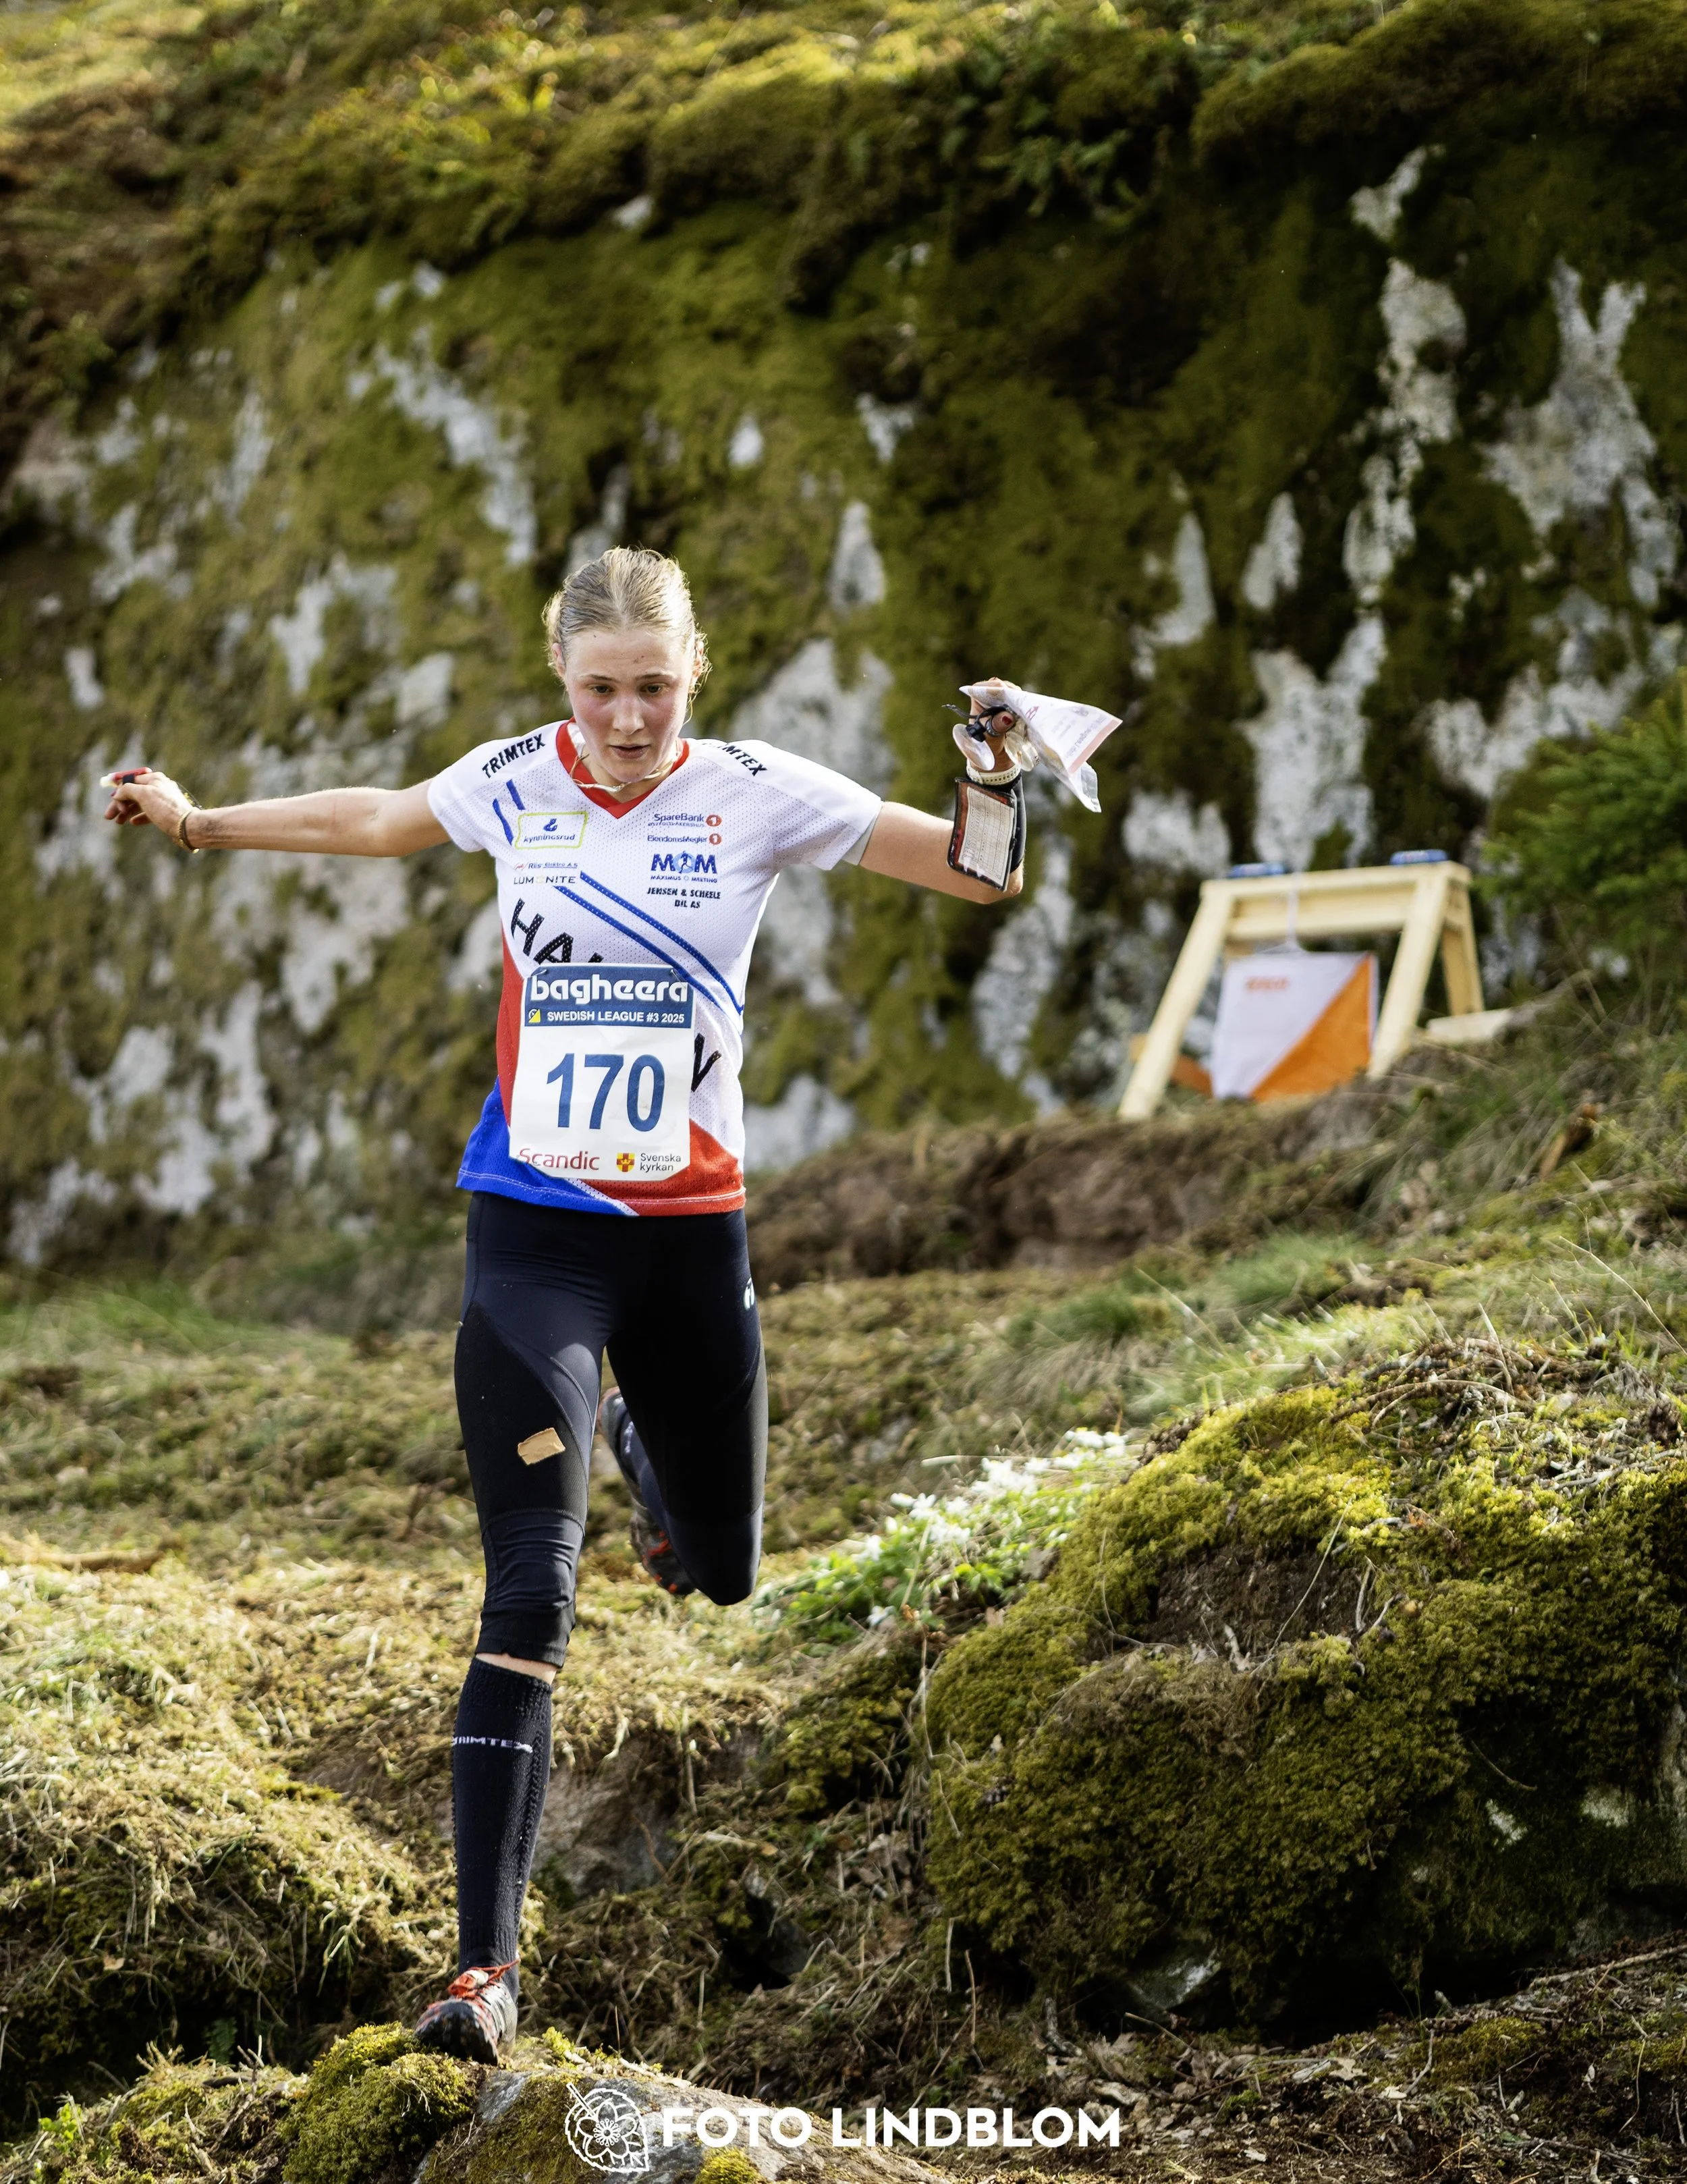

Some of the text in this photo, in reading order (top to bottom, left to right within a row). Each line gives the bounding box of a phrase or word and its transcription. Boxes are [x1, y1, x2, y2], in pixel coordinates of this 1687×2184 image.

[482, 733, 547, 779] TRIMTEX
[654, 813, 704, 823] SpareBank
[524, 834, 576, 844] kynningsrud
[647, 835, 707, 844] EiendomsMegler
[647, 887, 678, 896] JENSEN
[690, 890, 721, 899] SCHEELE
[674, 900, 700, 908] BIL AS
[530, 974, 688, 1004] bagheera
[547, 1010, 685, 1023] SWEDISH LEAGUE #3 2025
[547, 1053, 665, 1132] 170
[519, 1148, 600, 1170] Scandic
[640, 1153, 682, 1162] Svenska
[640, 1162, 674, 1172] kyrkan
